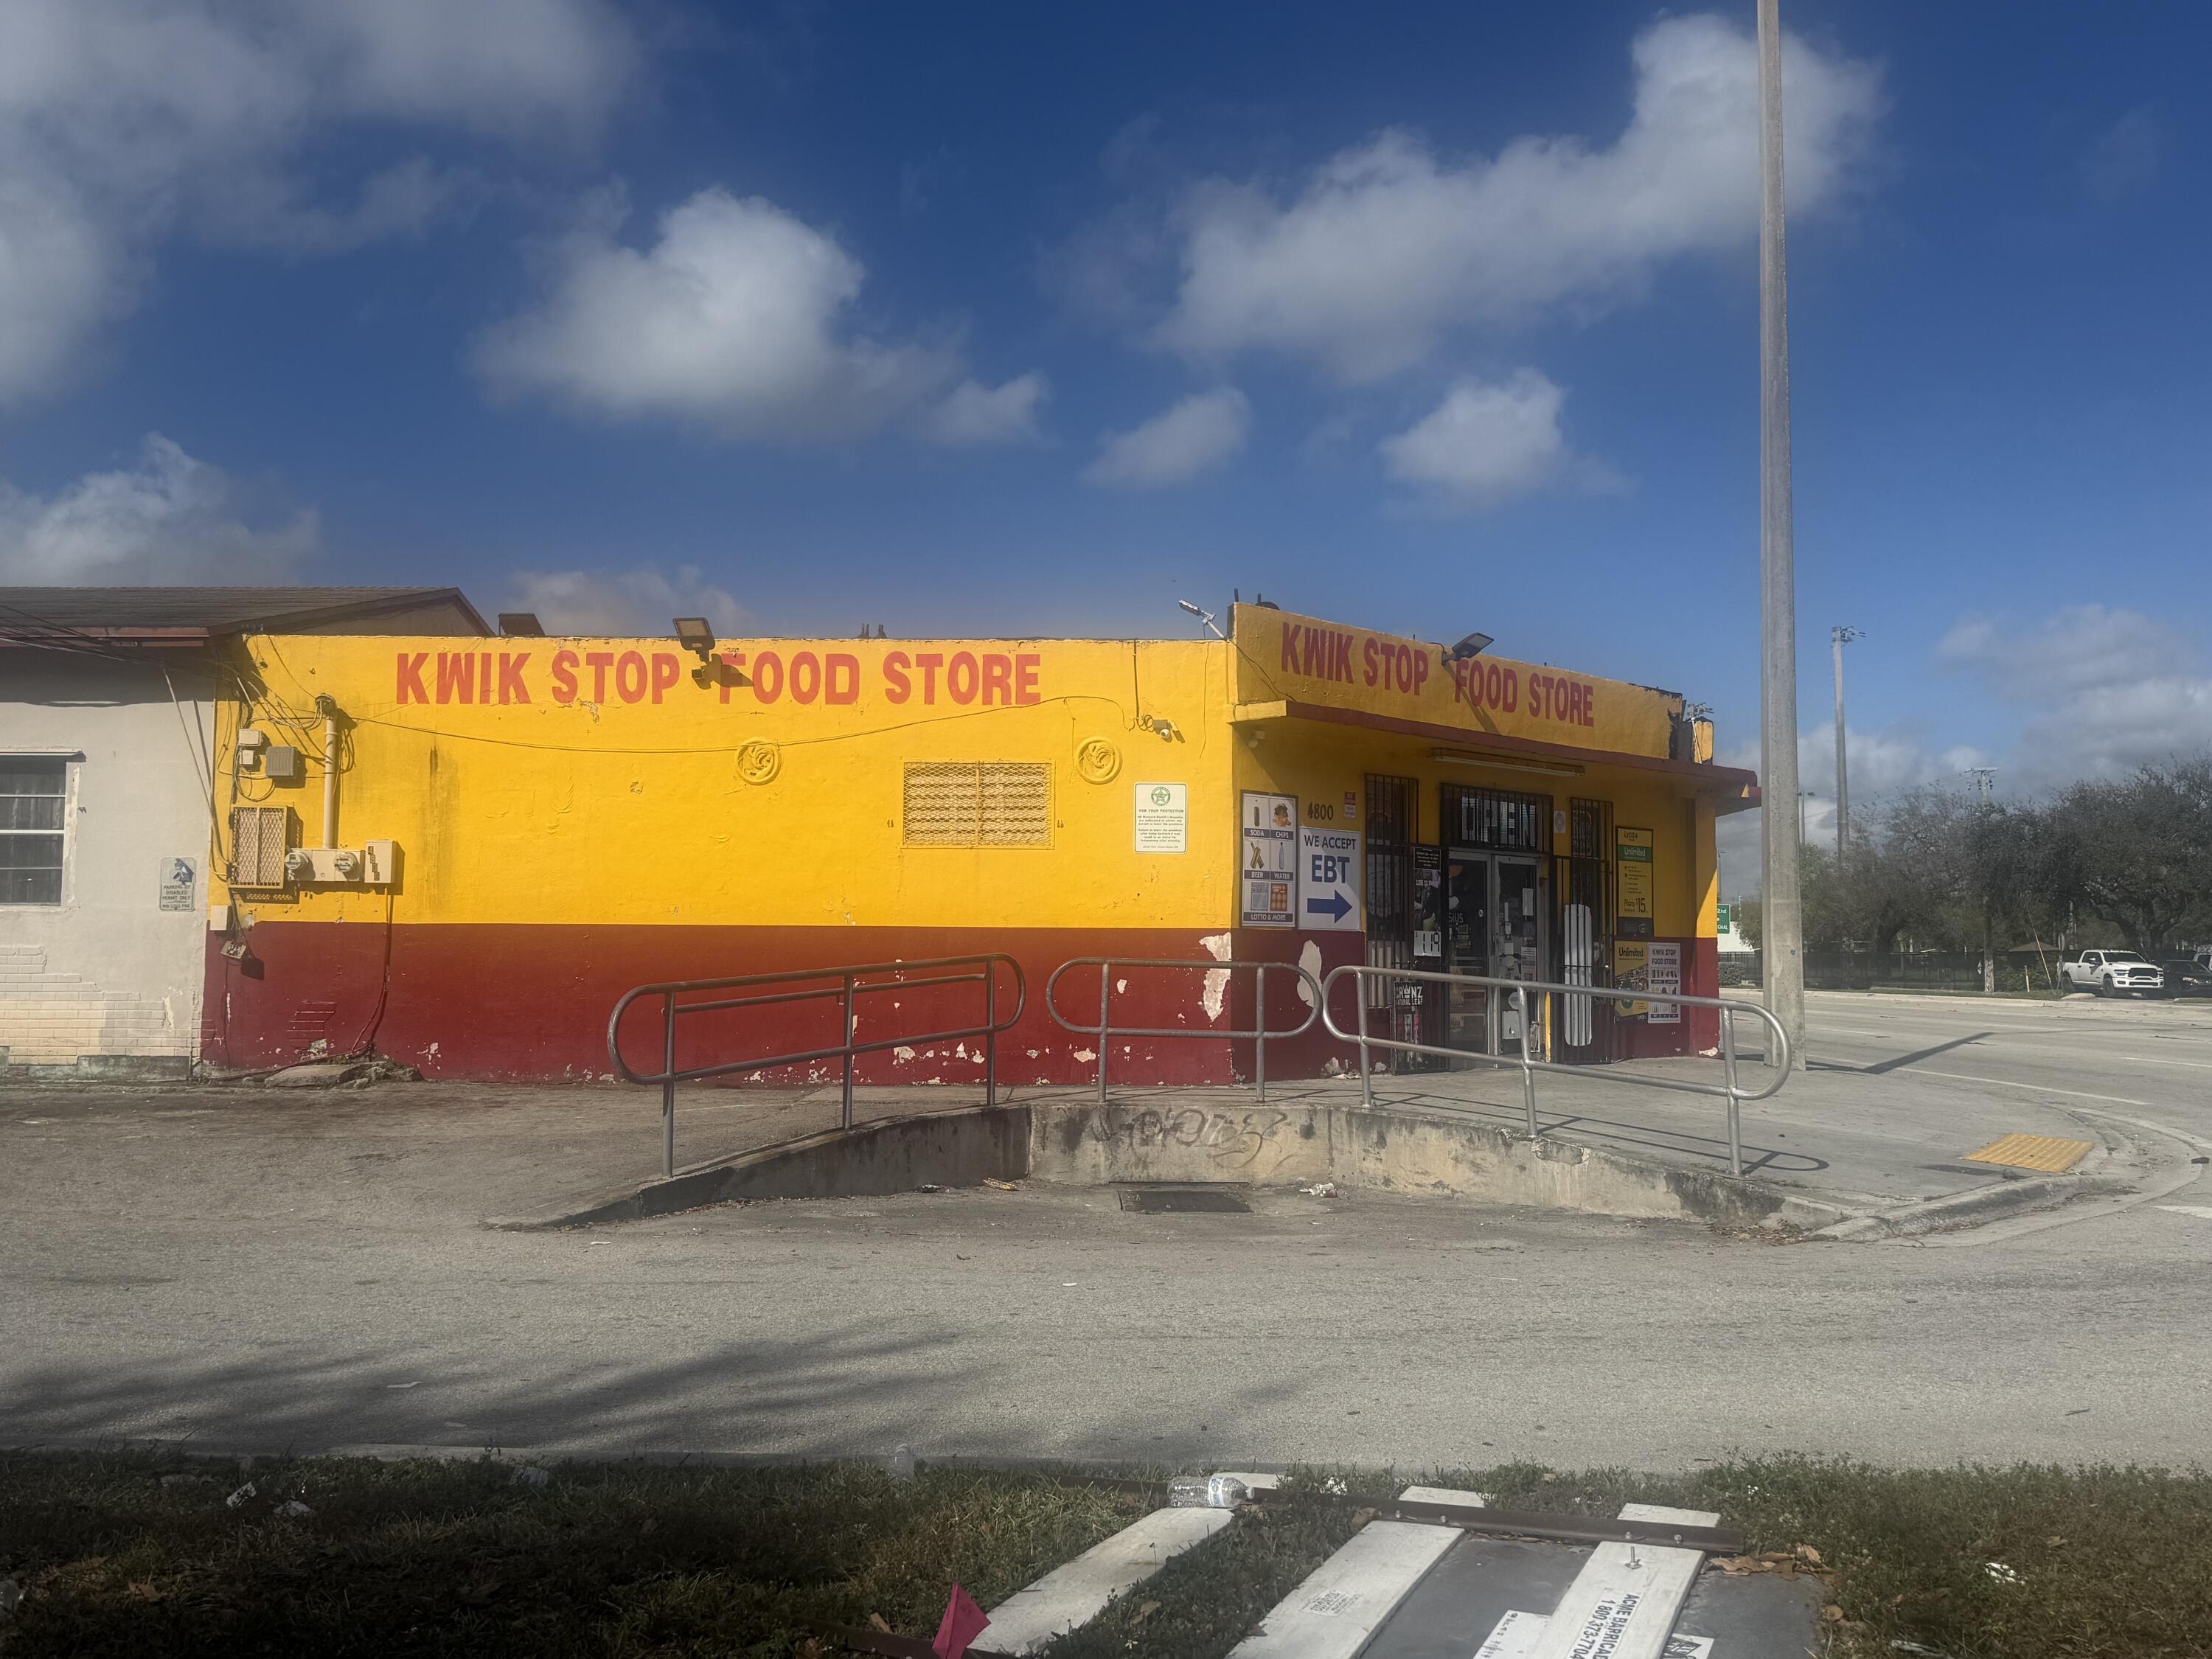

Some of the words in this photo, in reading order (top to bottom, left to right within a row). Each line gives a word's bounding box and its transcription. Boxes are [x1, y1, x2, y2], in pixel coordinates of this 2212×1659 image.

[396, 652, 532, 705] KWIK
[552, 650, 681, 705] STOP
[720, 653, 860, 706] FOOD
[885, 653, 1041, 706] STORE
[1281, 622, 1354, 684] KWIK
[1363, 637, 1429, 695] STOP
[1455, 658, 1518, 712] FOOD
[1529, 672, 1594, 727] STORE
[1307, 802, 1334, 821] 4800
[1304, 835, 1319, 847] WE
[1322, 836, 1356, 849] ACCEPT
[1312, 854, 1350, 884] EBT
[1618, 947, 1644, 958] Unlimited
[1592, 1605, 1613, 1620] 800
[1616, 1593, 1640, 1616] ACME
